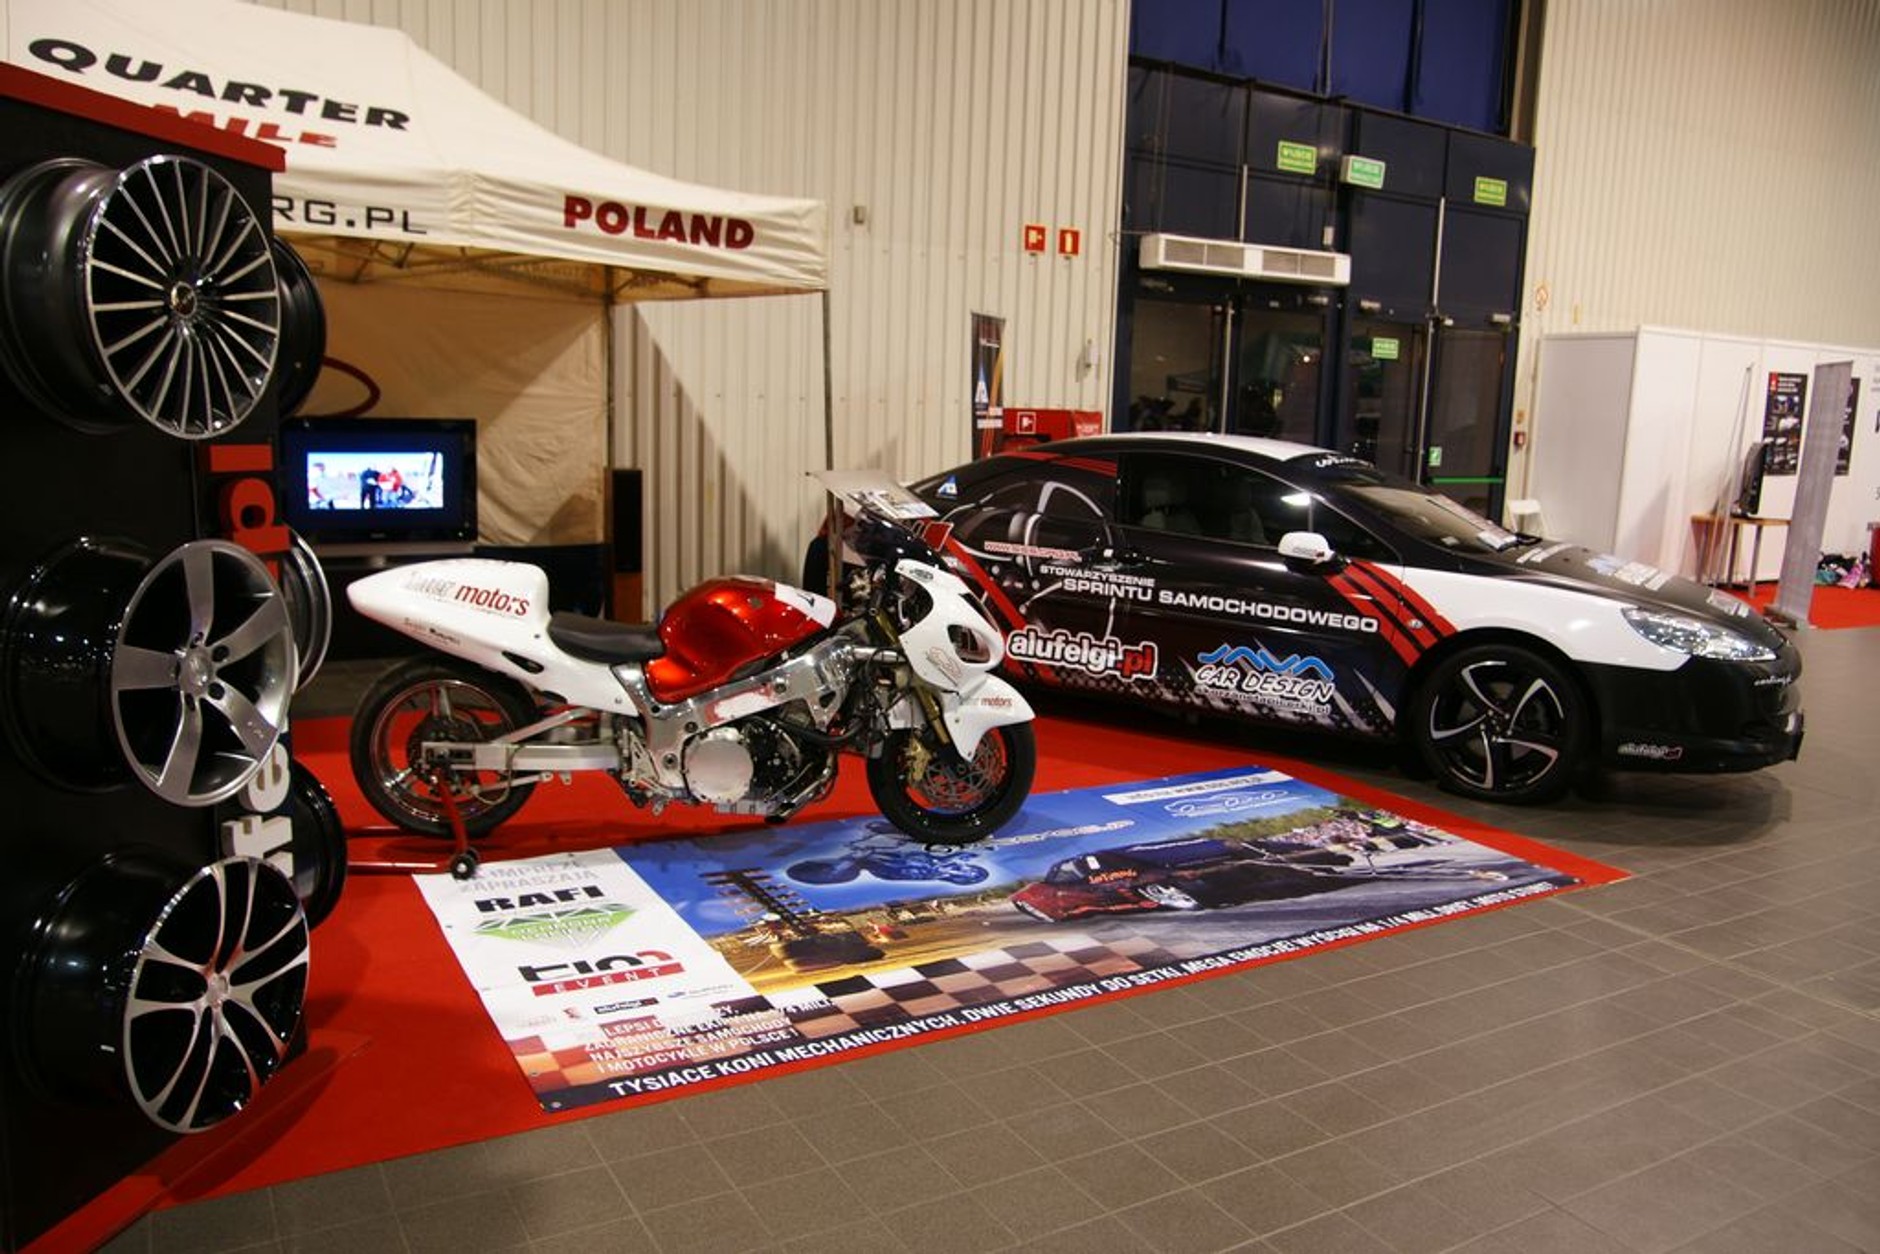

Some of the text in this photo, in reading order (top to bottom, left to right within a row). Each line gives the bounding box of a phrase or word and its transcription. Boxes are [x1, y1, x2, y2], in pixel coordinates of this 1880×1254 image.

[28, 38, 410, 131] QUARTER
[272, 194, 427, 235] RG.PL
[563, 194, 756, 251] POLAND
[1040, 564, 1156, 588] STOWARZYSZENIE
[454, 584, 530, 616] motors
[1063, 577, 1379, 633] SPRINTU SAMOCHODOWEGO
[1009, 631, 1155, 677] alufelgi.pl
[1196, 664, 1336, 703] CAR DESIGN
[474, 884, 606, 912] RAFI
[553, 966, 661, 993] EVENT
[719, 1052, 776, 1077] KONI
[778, 1012, 966, 1067] MECHANICZNYCH,
[962, 1001, 1017, 1022] DWIE
[1016, 982, 1103, 1011] SEKUNDY
[1099, 977, 1129, 993] DO
[608, 1046, 708, 1073] MOTOCYKLE
[731, 1030, 790, 1053] POLSCE
